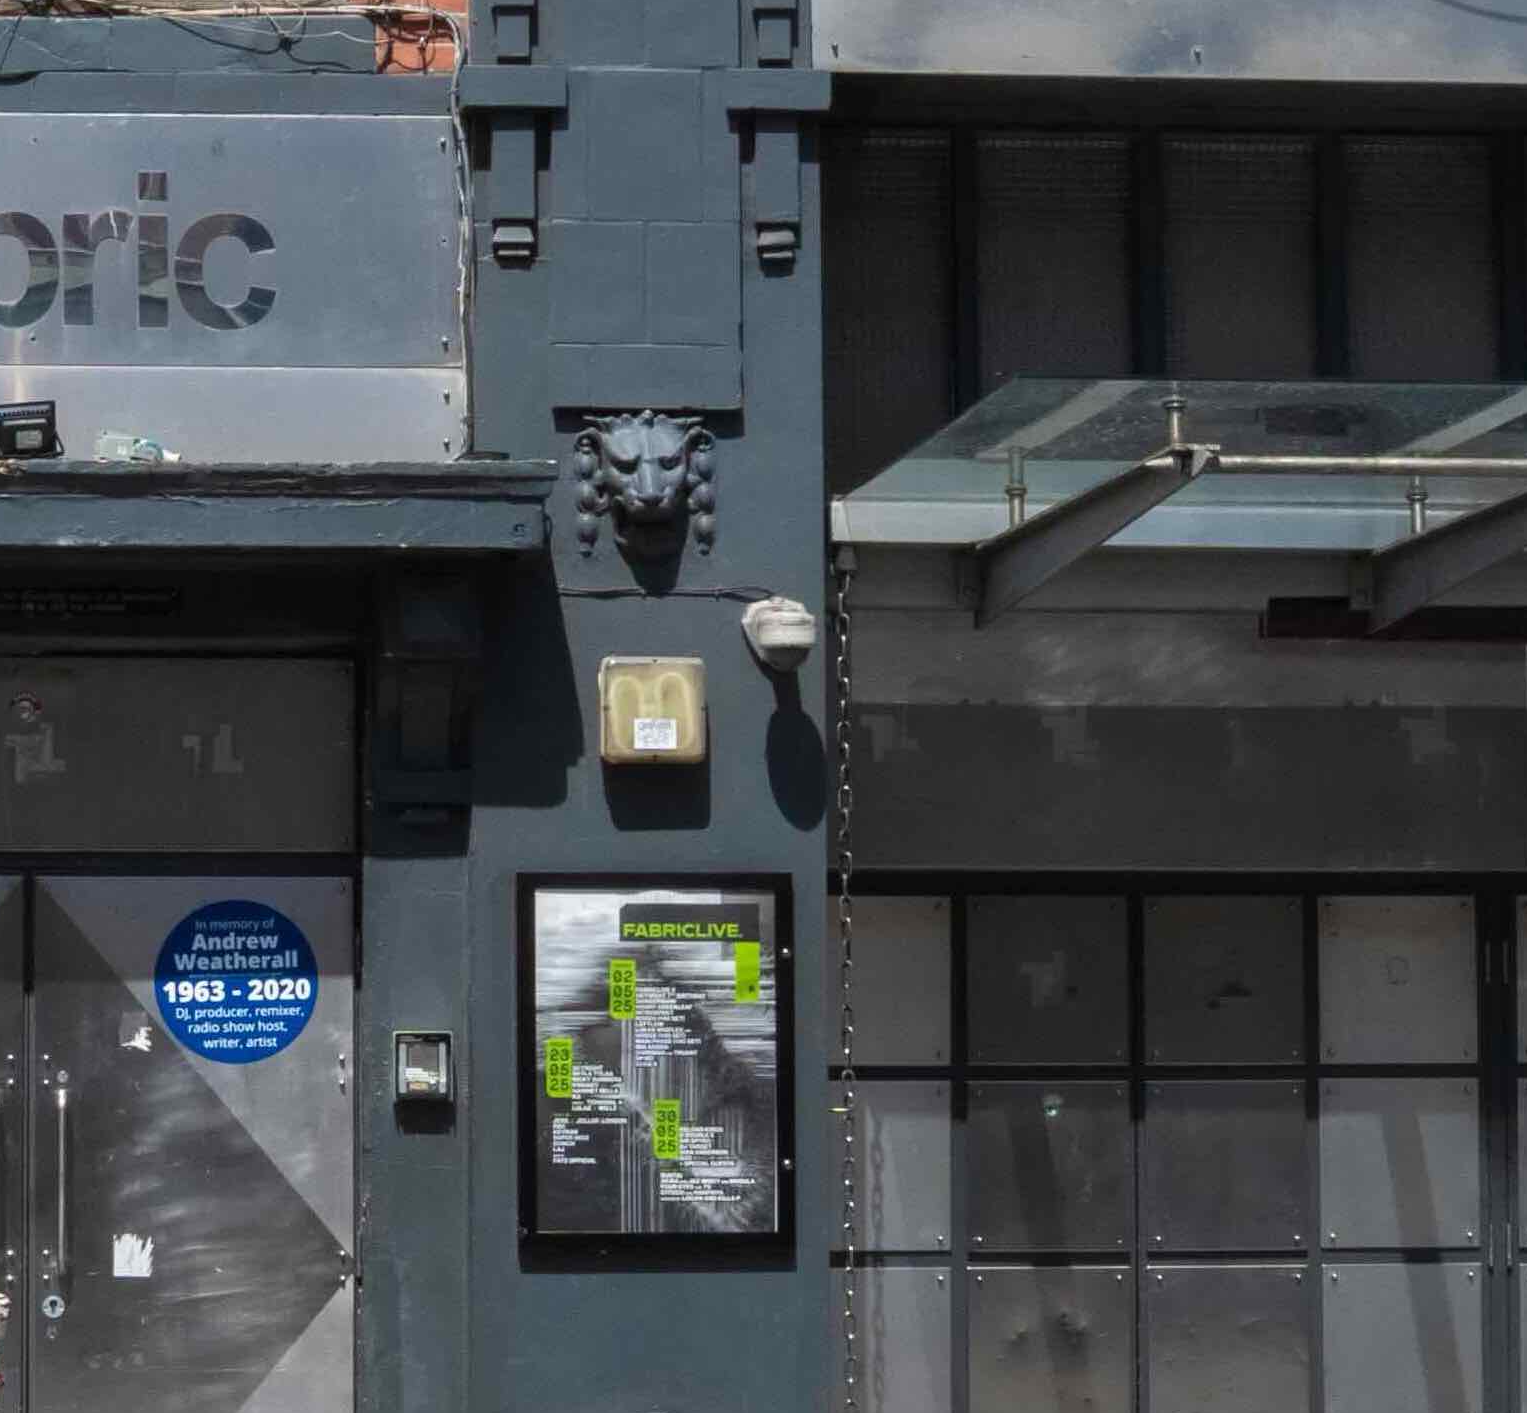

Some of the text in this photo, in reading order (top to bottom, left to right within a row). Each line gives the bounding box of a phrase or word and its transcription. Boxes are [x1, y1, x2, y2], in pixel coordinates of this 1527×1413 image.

[195, 917, 275, 932] In memory of
[191, 932, 279, 950] Andrew
[174, 950, 298, 970] Weatherall
[613, 971, 632, 983] 02
[163, 981, 225, 1003] 1963
[248, 978, 311, 1001] 2020
[613, 986, 632, 997] 05
[613, 1000, 632, 1012] 25
[194, 1007, 251, 1021] producer,
[255, 1005, 304, 1018] remixer,
[188, 1020, 288, 1034] radio show host,
[203, 1036, 277, 1049] writer, artist
[549, 1049, 569, 1061] 23
[549, 1063, 569, 1076] 05
[549, 1078, 569, 1091] 25
[657, 1111, 676, 1122] 30
[657, 1125, 676, 1137] 05
[657, 1140, 676, 1152] 25
